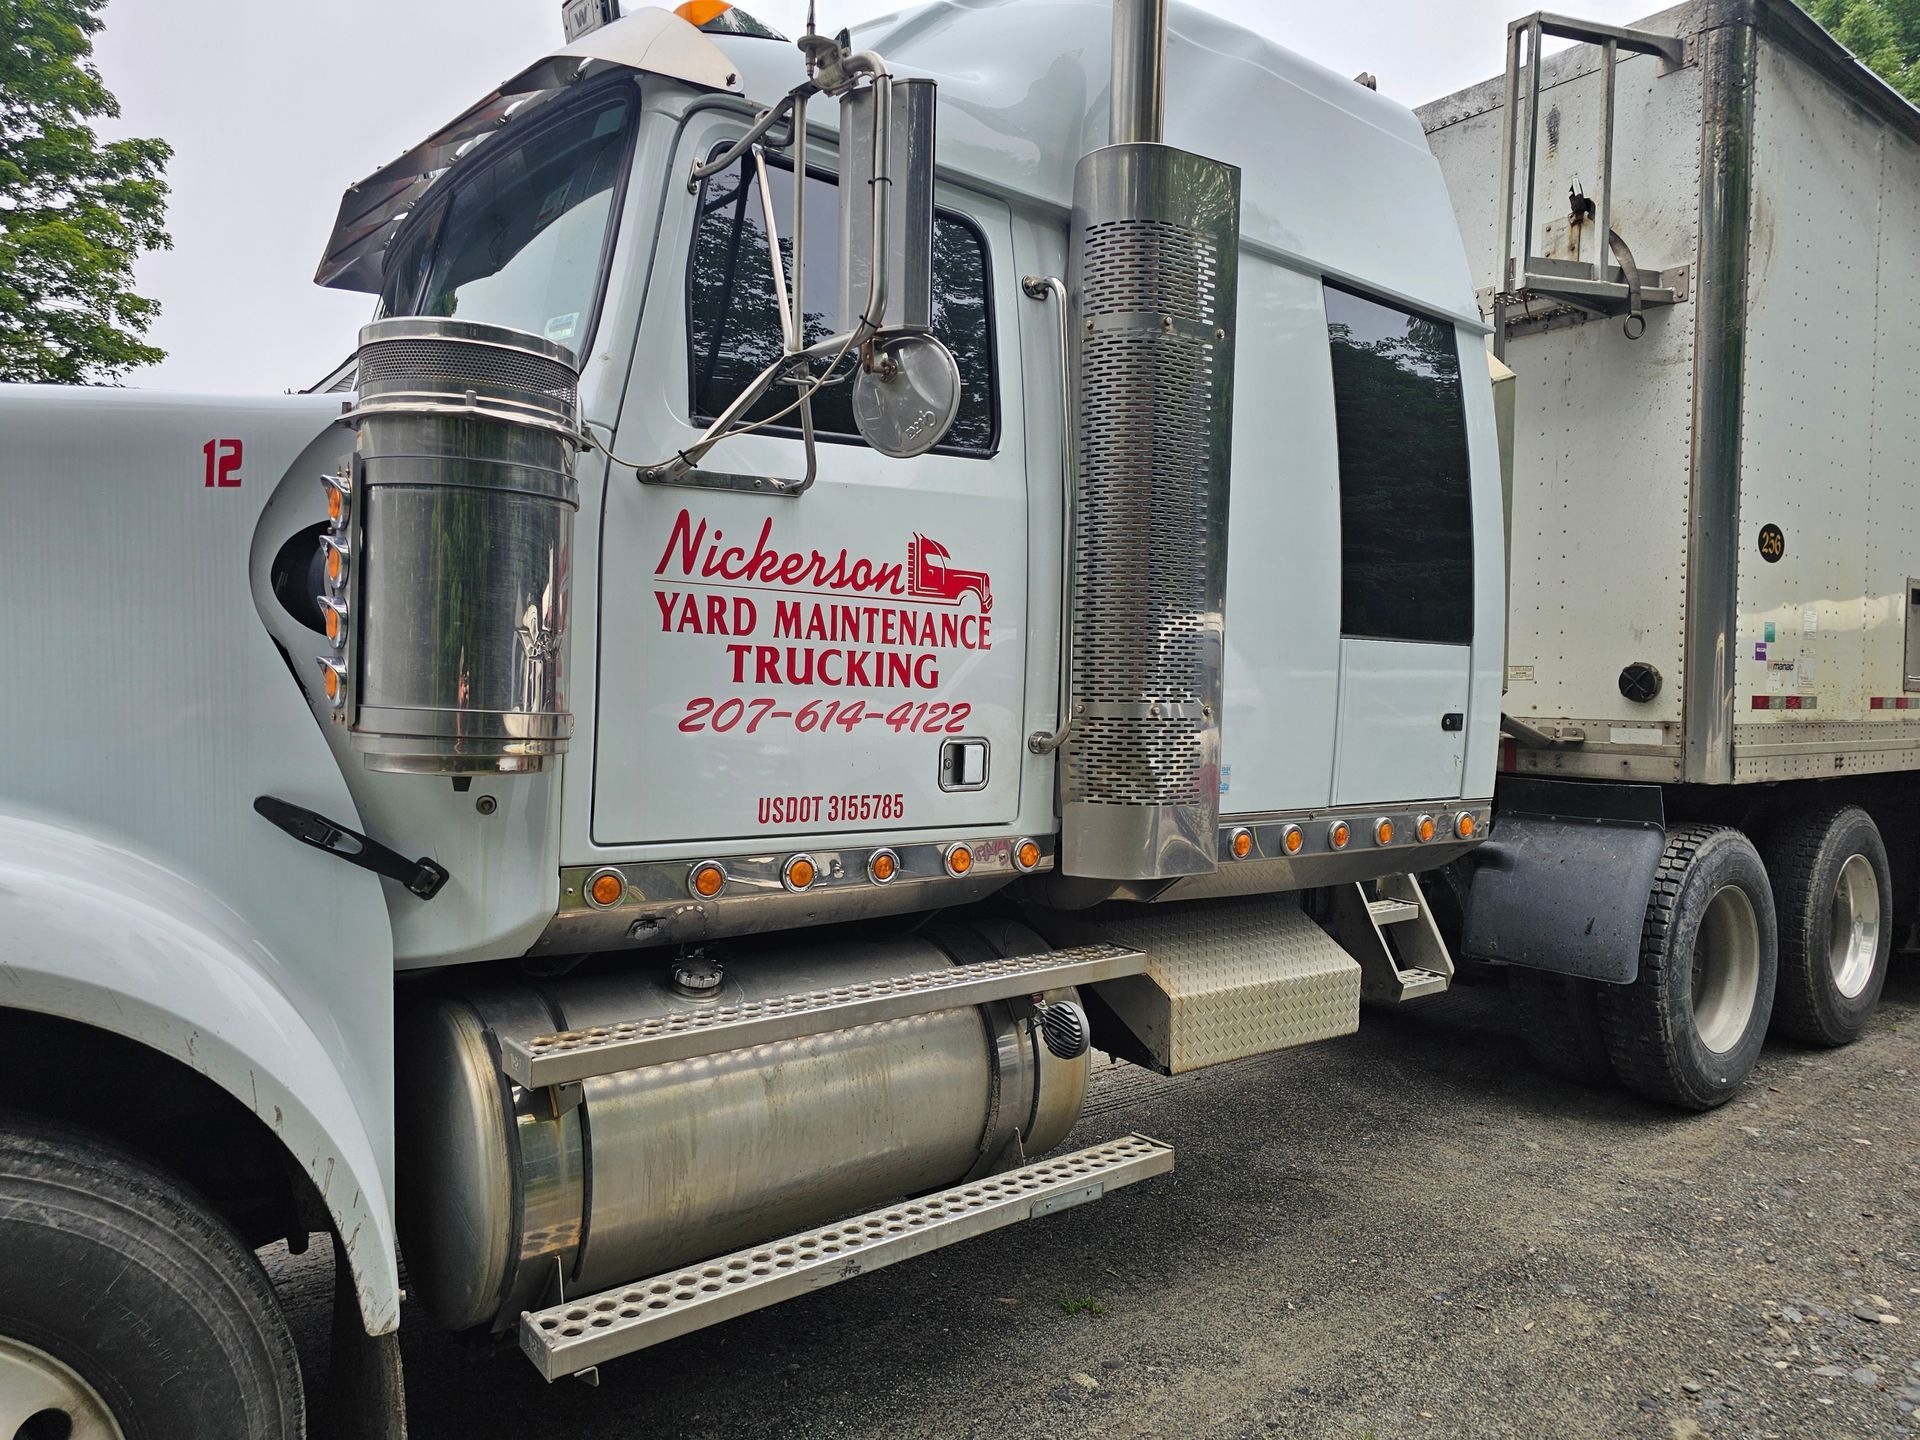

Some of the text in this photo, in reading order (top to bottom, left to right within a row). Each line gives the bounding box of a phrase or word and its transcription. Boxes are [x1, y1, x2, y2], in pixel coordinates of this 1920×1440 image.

[203, 438, 243, 488] 12
[654, 508, 905, 596] Nickerson
[1762, 531, 1782, 556] 256
[654, 591, 993, 651] YARD MAINTENANCE
[726, 643, 940, 690] TRUCKING
[1773, 662, 1795, 672] manac
[677, 696, 973, 735] 207-614-4122
[757, 793, 904, 826] USDOT 3155785
